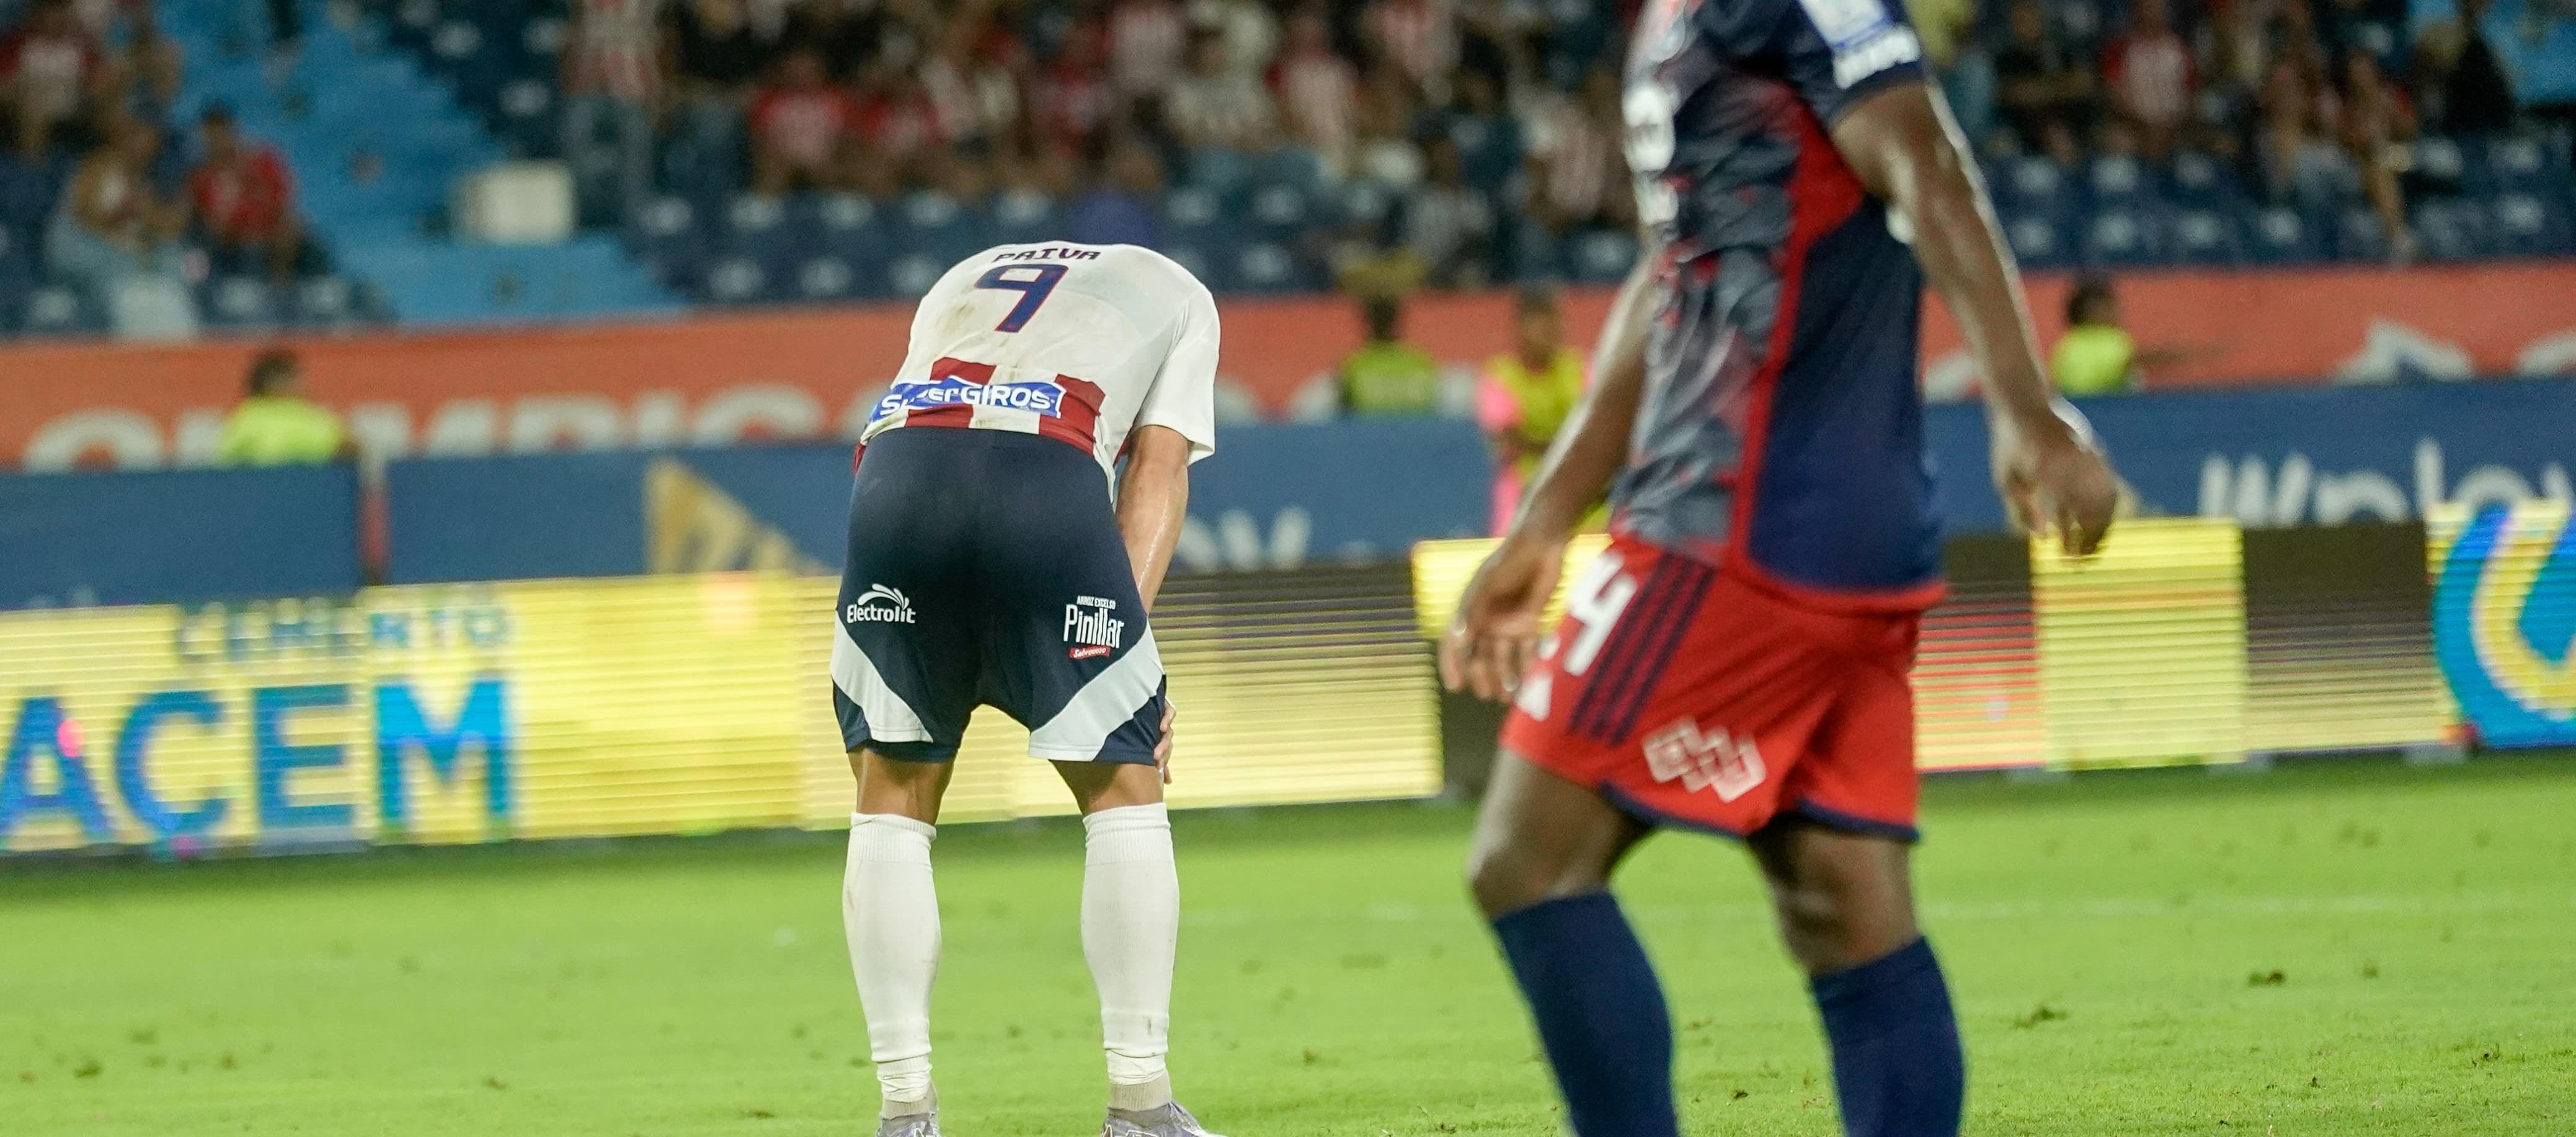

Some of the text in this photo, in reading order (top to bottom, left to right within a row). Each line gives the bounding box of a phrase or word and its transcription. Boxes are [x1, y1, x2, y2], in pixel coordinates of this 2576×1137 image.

[992, 248, 1101, 263] PAIVA
[973, 264, 1069, 333] 9
[846, 603, 916, 624] Electrolit
[1064, 603, 1124, 648] Pinillar
[0, 677, 515, 851] ACEM
